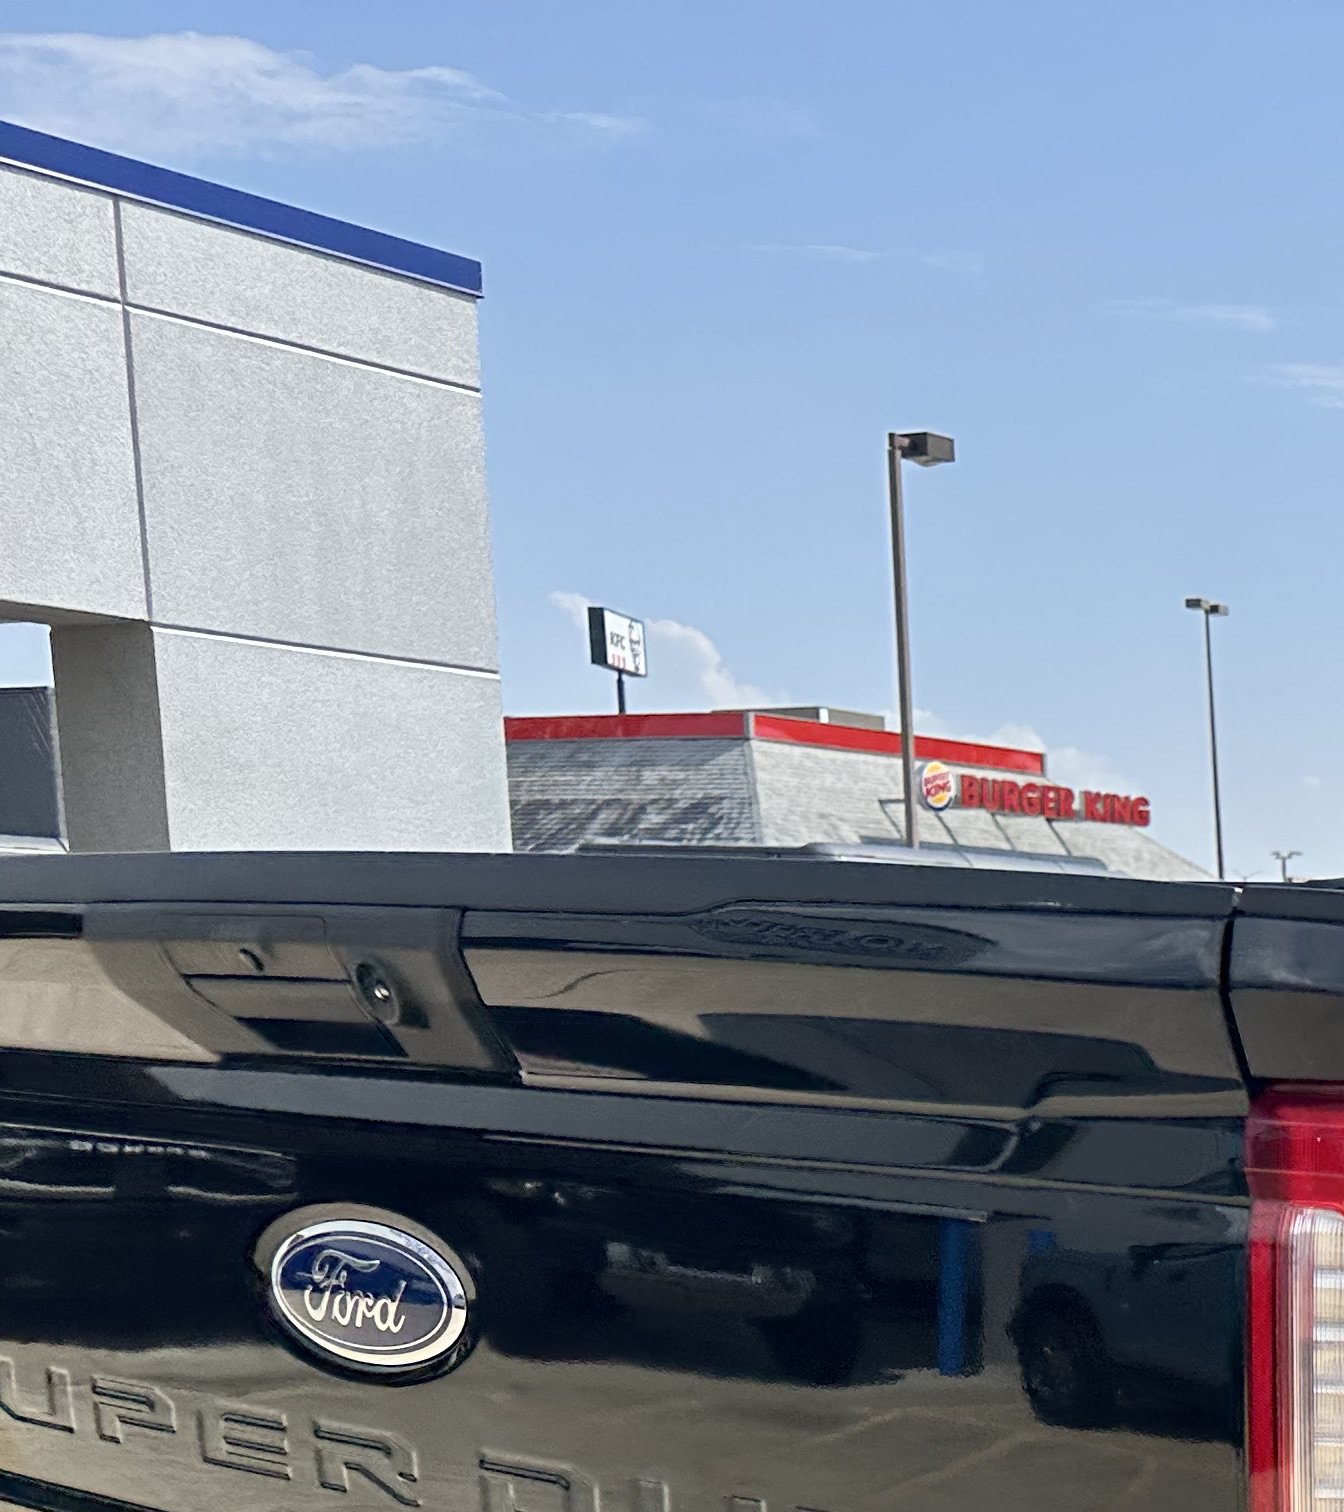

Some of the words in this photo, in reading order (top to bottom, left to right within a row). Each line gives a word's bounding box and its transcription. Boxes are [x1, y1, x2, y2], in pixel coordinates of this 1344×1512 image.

[609, 631, 626, 651] KFC
[960, 774, 1076, 821] BURGER
[1082, 790, 1151, 827] KING
[299, 1249, 407, 1334] Ford
